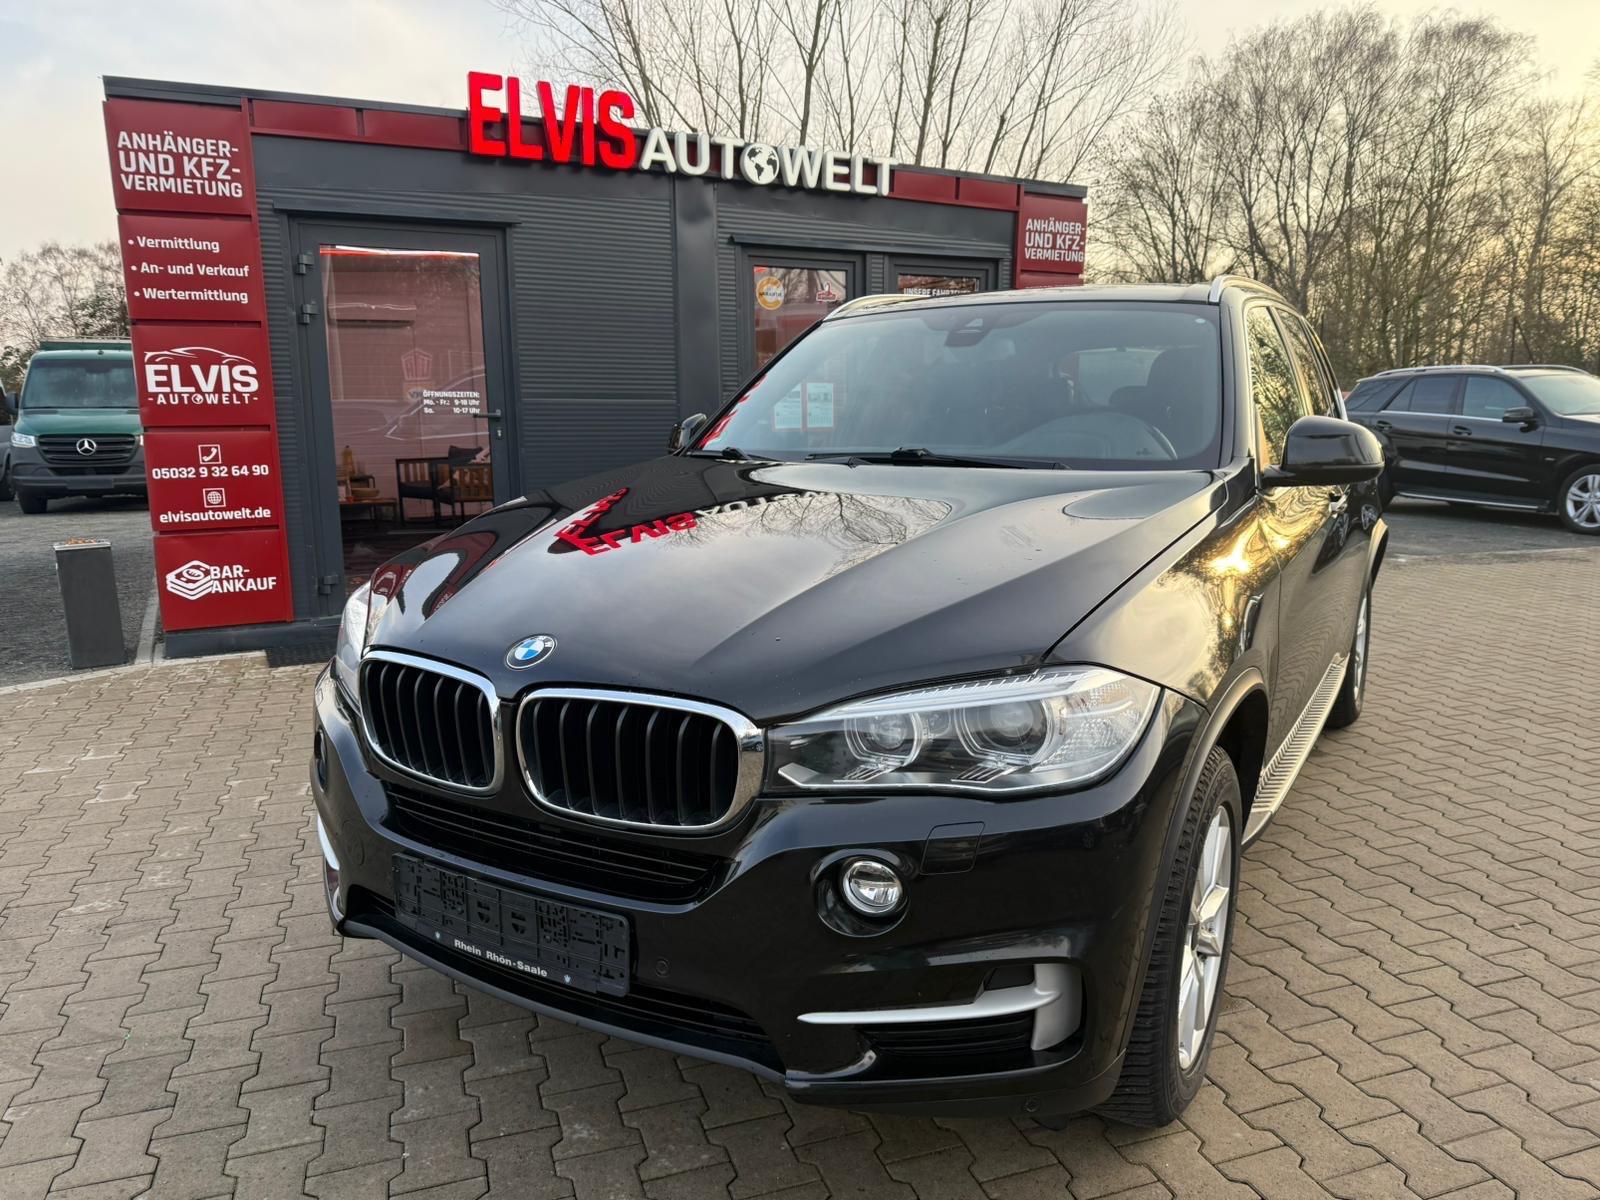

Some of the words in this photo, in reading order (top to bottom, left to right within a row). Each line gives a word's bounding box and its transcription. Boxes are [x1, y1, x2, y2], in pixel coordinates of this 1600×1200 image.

[467, 71, 635, 170] ELVIS
[117, 131, 239, 157] ANHÄNGER-
[119, 151, 175, 176] UND
[183, 156, 240, 180] KFZ-
[121, 173, 243, 198] VERMIETUNG
[1025, 217, 1086, 235] ANHÄNGER-
[137, 236, 220, 253] Vermittlung
[1025, 231, 1053, 249] UND
[1056, 233, 1085, 250] KFZ-
[1024, 247, 1084, 262] VERMIETUNG
[140, 261, 165, 275] An-
[167, 263, 194, 275] und
[197, 264, 250, 278] Verkauf
[143, 287, 249, 304] Wertermittlung
[145, 364, 259, 393] ELVIS
[152, 466, 196, 480] 05032
[199, 466, 208, 479] 9
[211, 465, 229, 479] 32
[231, 464, 250, 477] 64
[252, 464, 269, 477] 90
[159, 506, 271, 524] elvisautowelt.de
[210, 564, 250, 579] BAR-
[211, 576, 277, 594] ANKAUF
[454, 938, 482, 957] Rhein
